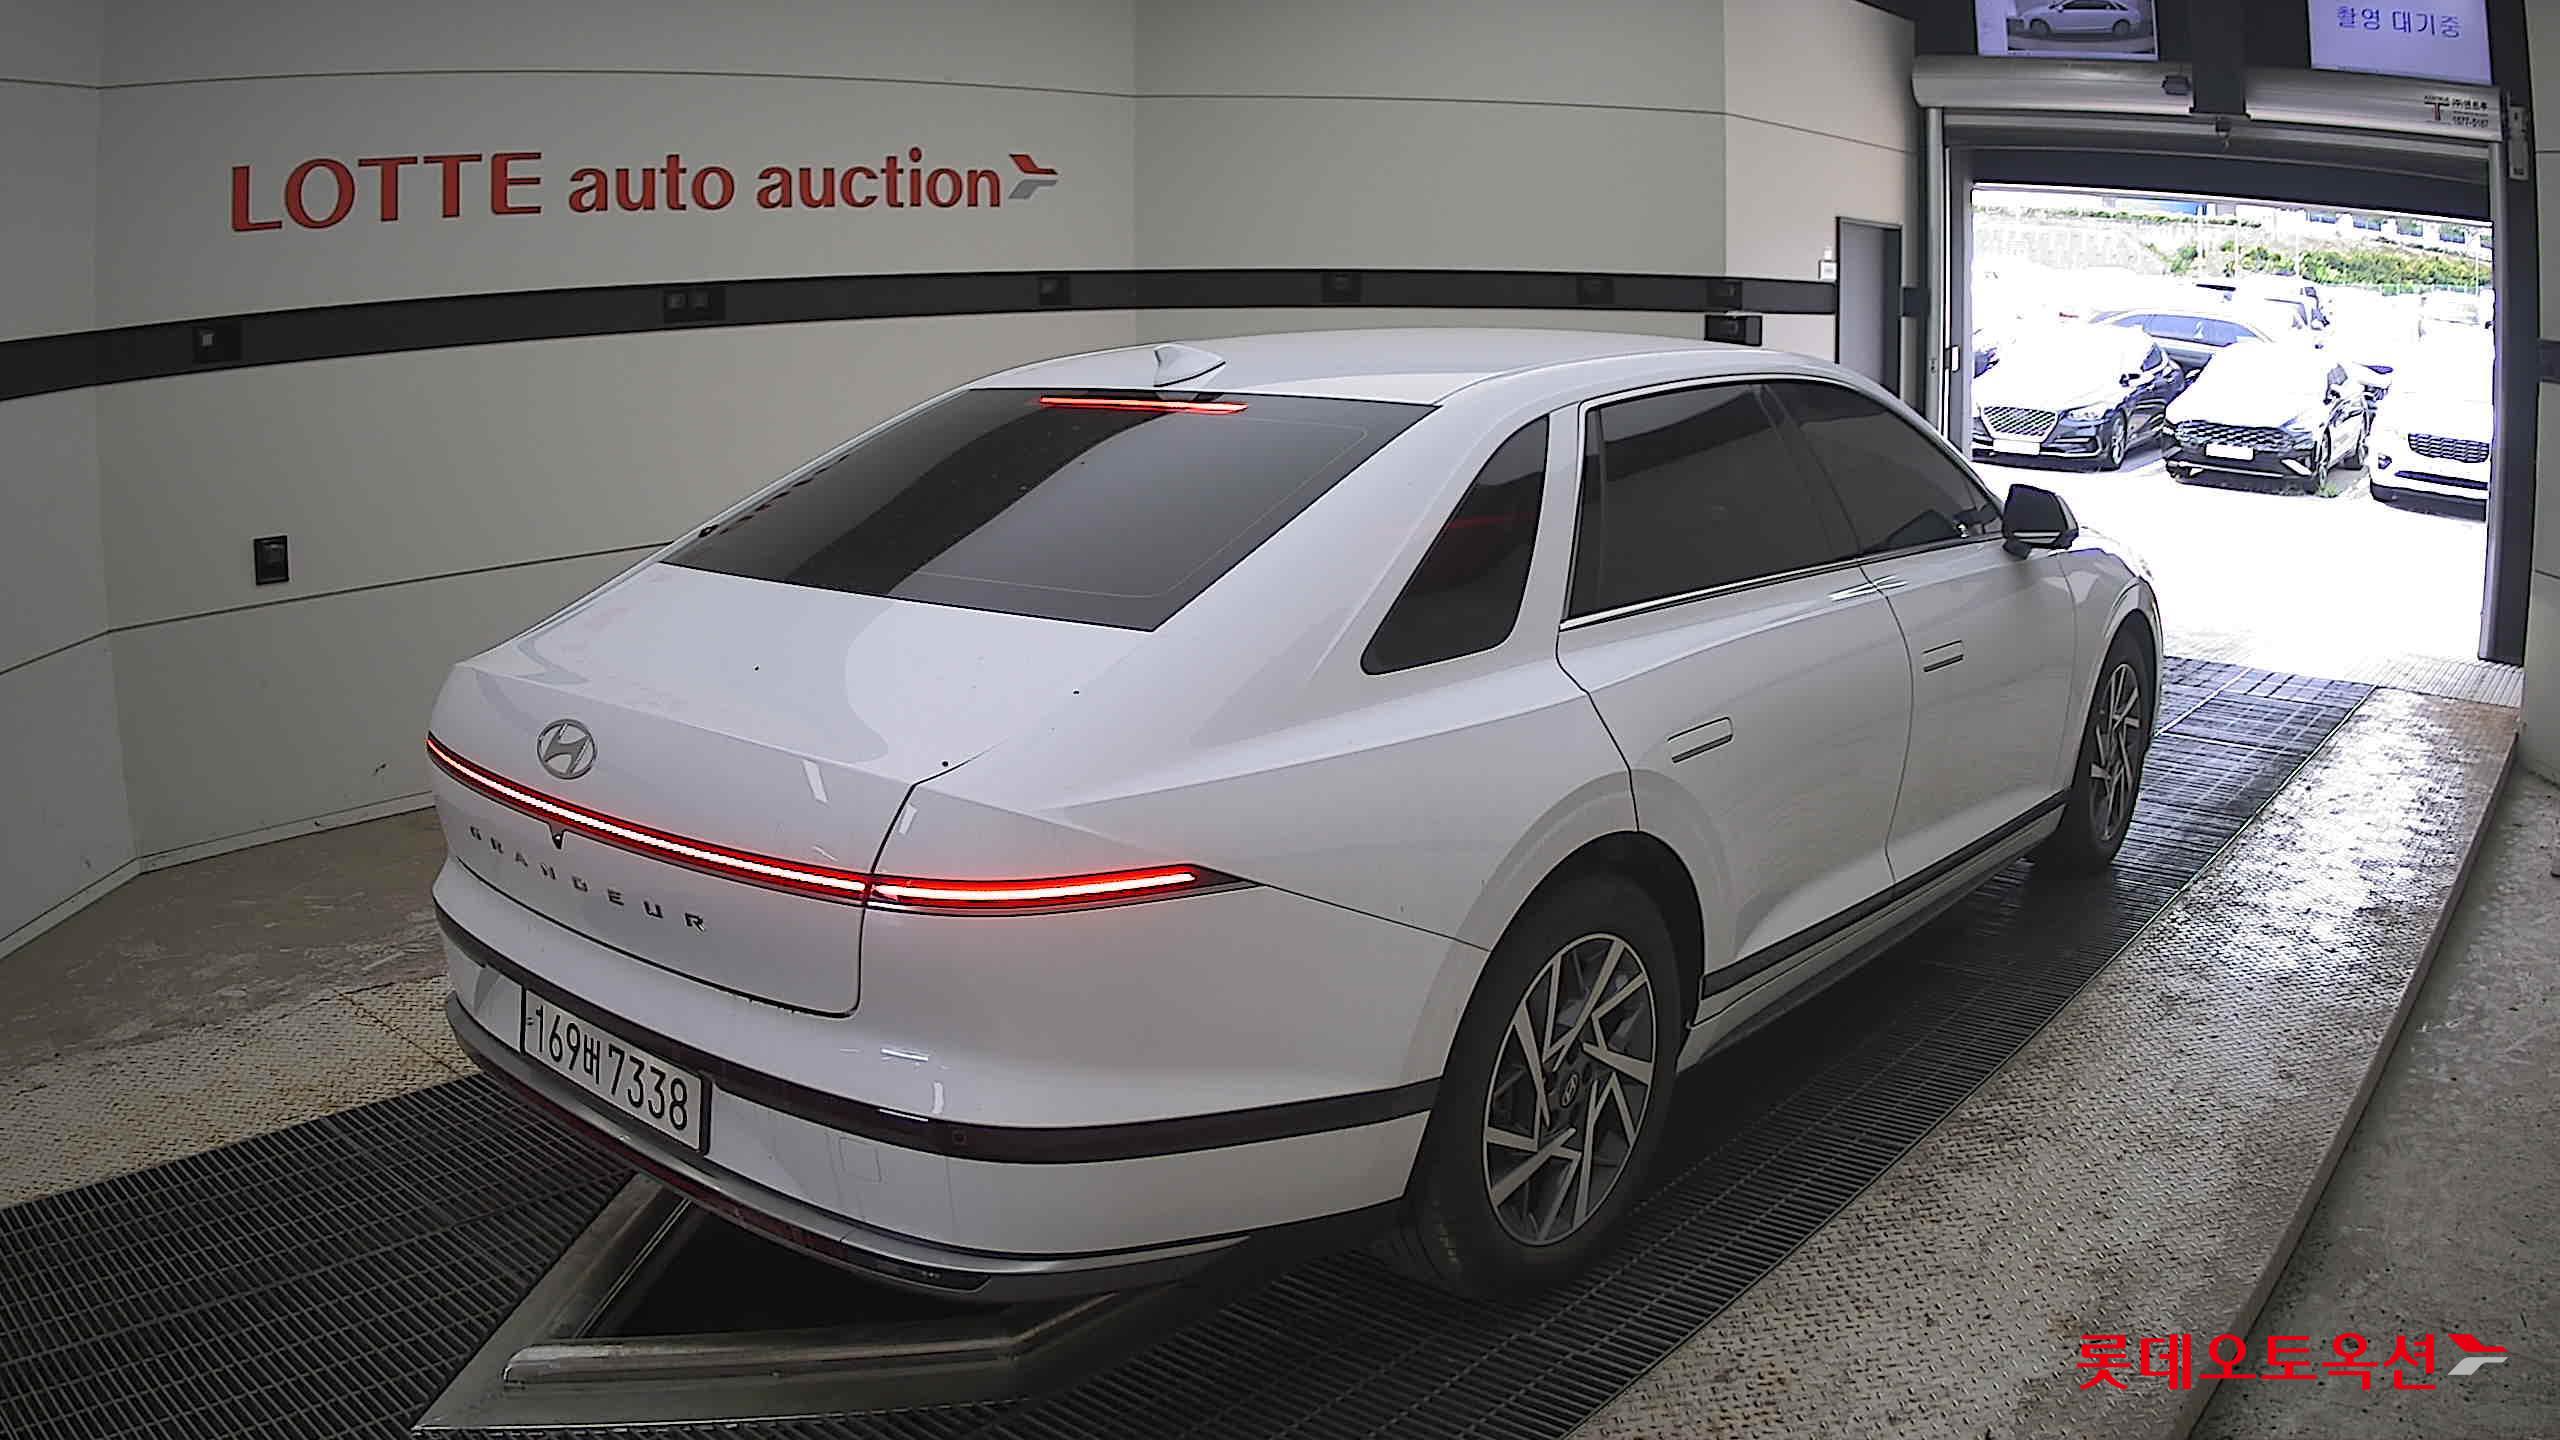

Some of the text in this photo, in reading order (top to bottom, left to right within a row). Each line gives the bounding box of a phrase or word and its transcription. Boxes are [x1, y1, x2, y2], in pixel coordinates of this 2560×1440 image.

[2337, 5, 2461, 39] 촬영 대기중
[230, 146, 1001, 233] LOTTE auto auction
[469, 825, 706, 932] GRANDEUR
